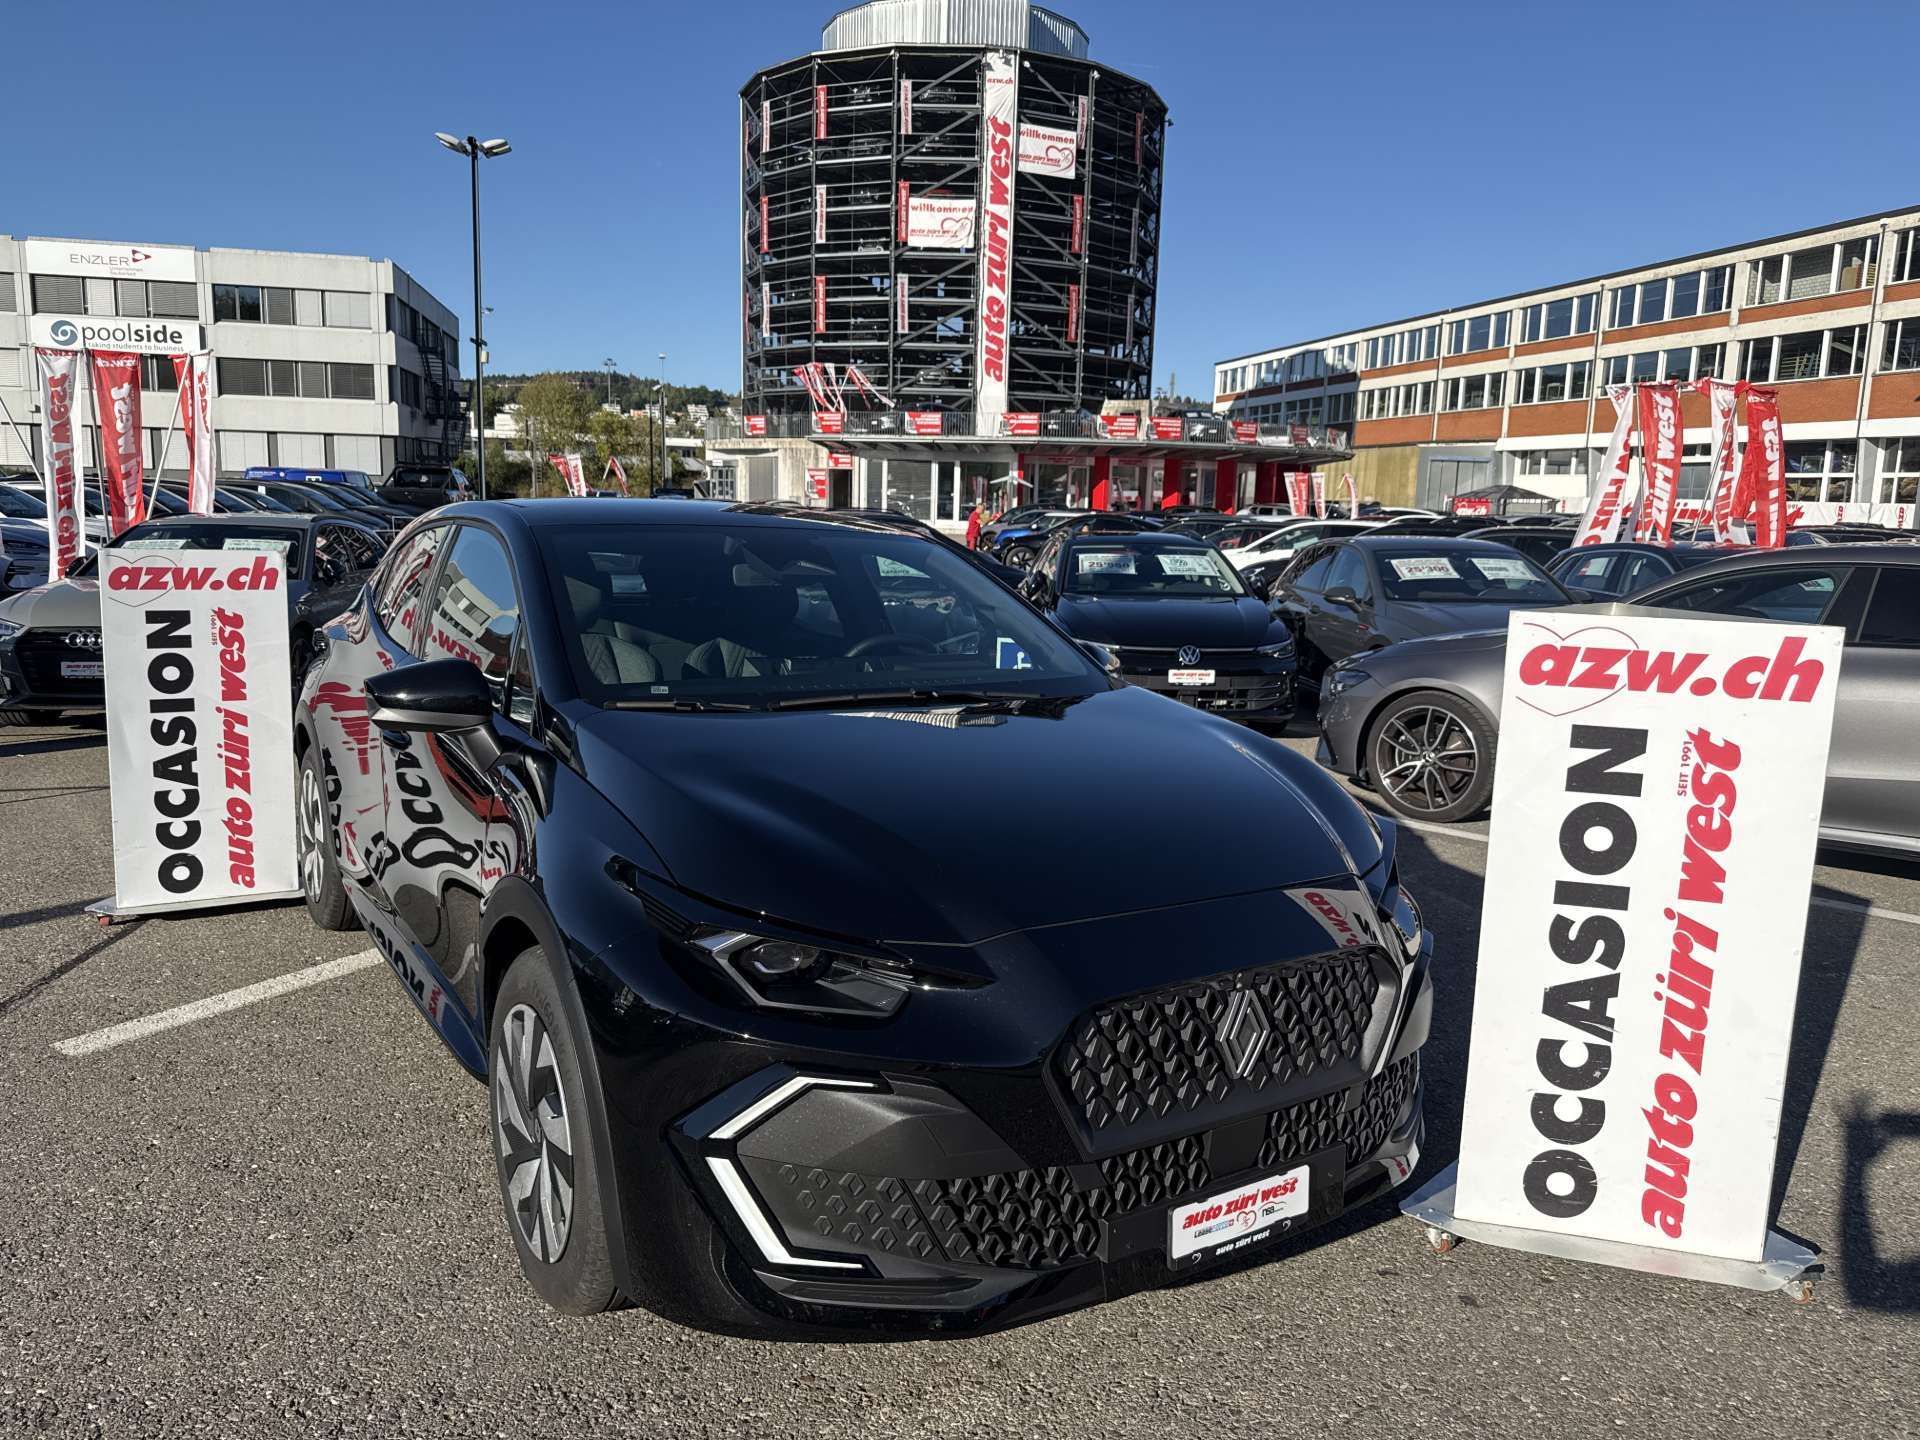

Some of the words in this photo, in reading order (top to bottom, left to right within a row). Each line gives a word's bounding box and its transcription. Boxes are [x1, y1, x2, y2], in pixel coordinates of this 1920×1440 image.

[987, 115, 1012, 205] west
[1019, 127, 1075, 145] willkommen
[70, 254, 129, 265] ENZLER
[82, 323, 183, 347] poolside
[112, 343, 142, 351] students
[982, 295, 1005, 383] auto
[1654, 392, 1677, 459] west
[109, 557, 278, 591] azw.ch
[213, 607, 246, 702] west
[1519, 637, 1825, 703] azw.ch
[145, 611, 203, 894] OCCASION
[215, 706, 252, 795] züri
[1680, 740, 1693, 767] 1991
[1677, 772, 1689, 797] SEIT
[1678, 726, 1742, 905] west
[221, 797, 256, 889] auto
[1523, 724, 1649, 1218] OCCASION
[1653, 907, 1719, 1076] züri
[1642, 1073, 1698, 1239] auto
[1183, 1204, 1222, 1229] auto
[1222, 1189, 1260, 1216] züri
[1261, 1177, 1298, 1203] west
[1215, 1243, 1233, 1255] auto
[1234, 1234, 1251, 1249] züri
[1252, 1229, 1270, 1243] west
